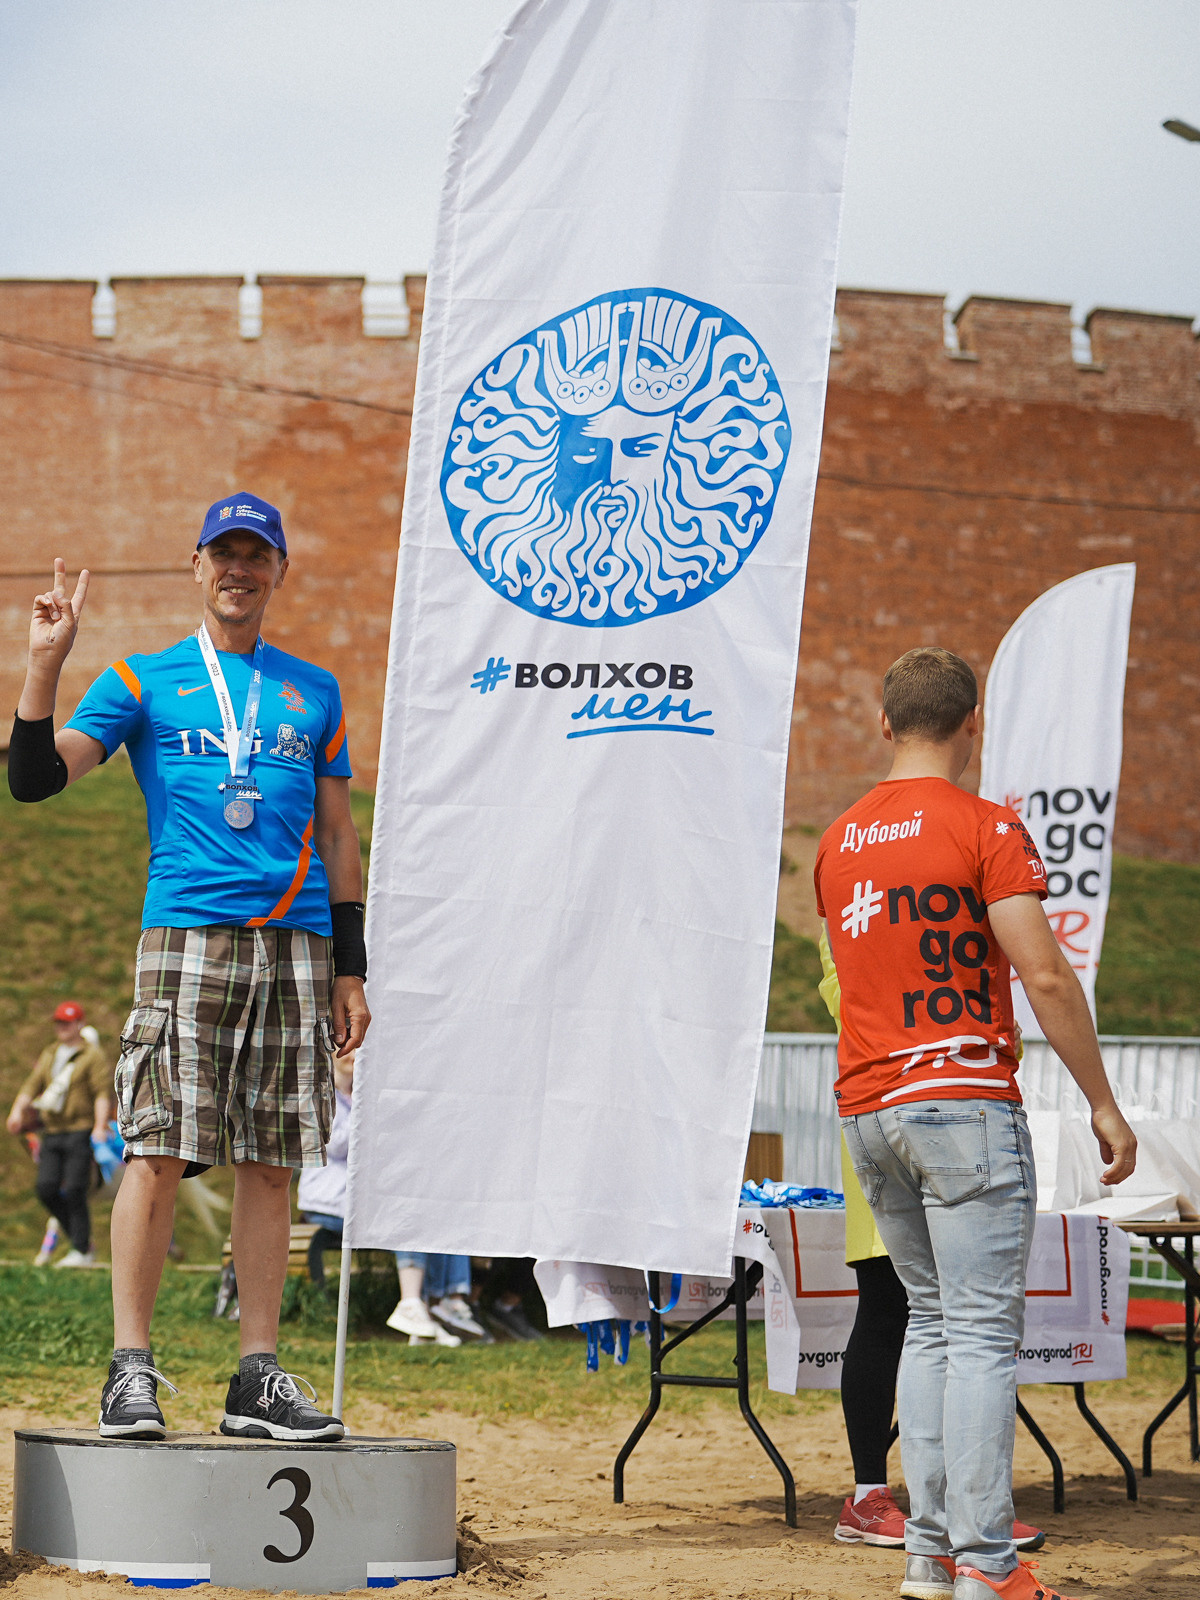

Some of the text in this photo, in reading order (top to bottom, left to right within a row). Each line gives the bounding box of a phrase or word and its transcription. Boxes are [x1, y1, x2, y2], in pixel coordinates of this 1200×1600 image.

[210, 662, 220, 676] 2023
[253, 669, 261, 684] 2023
[470, 656, 694, 694] #ВОЛХОВ
[571, 692, 713, 723] мен
[840, 810, 923, 853] Дубовой
[841, 879, 988, 939] #nov
[919, 928, 989, 983] go
[902, 968, 993, 1028] rod
[263, 1467, 314, 1563] 3
